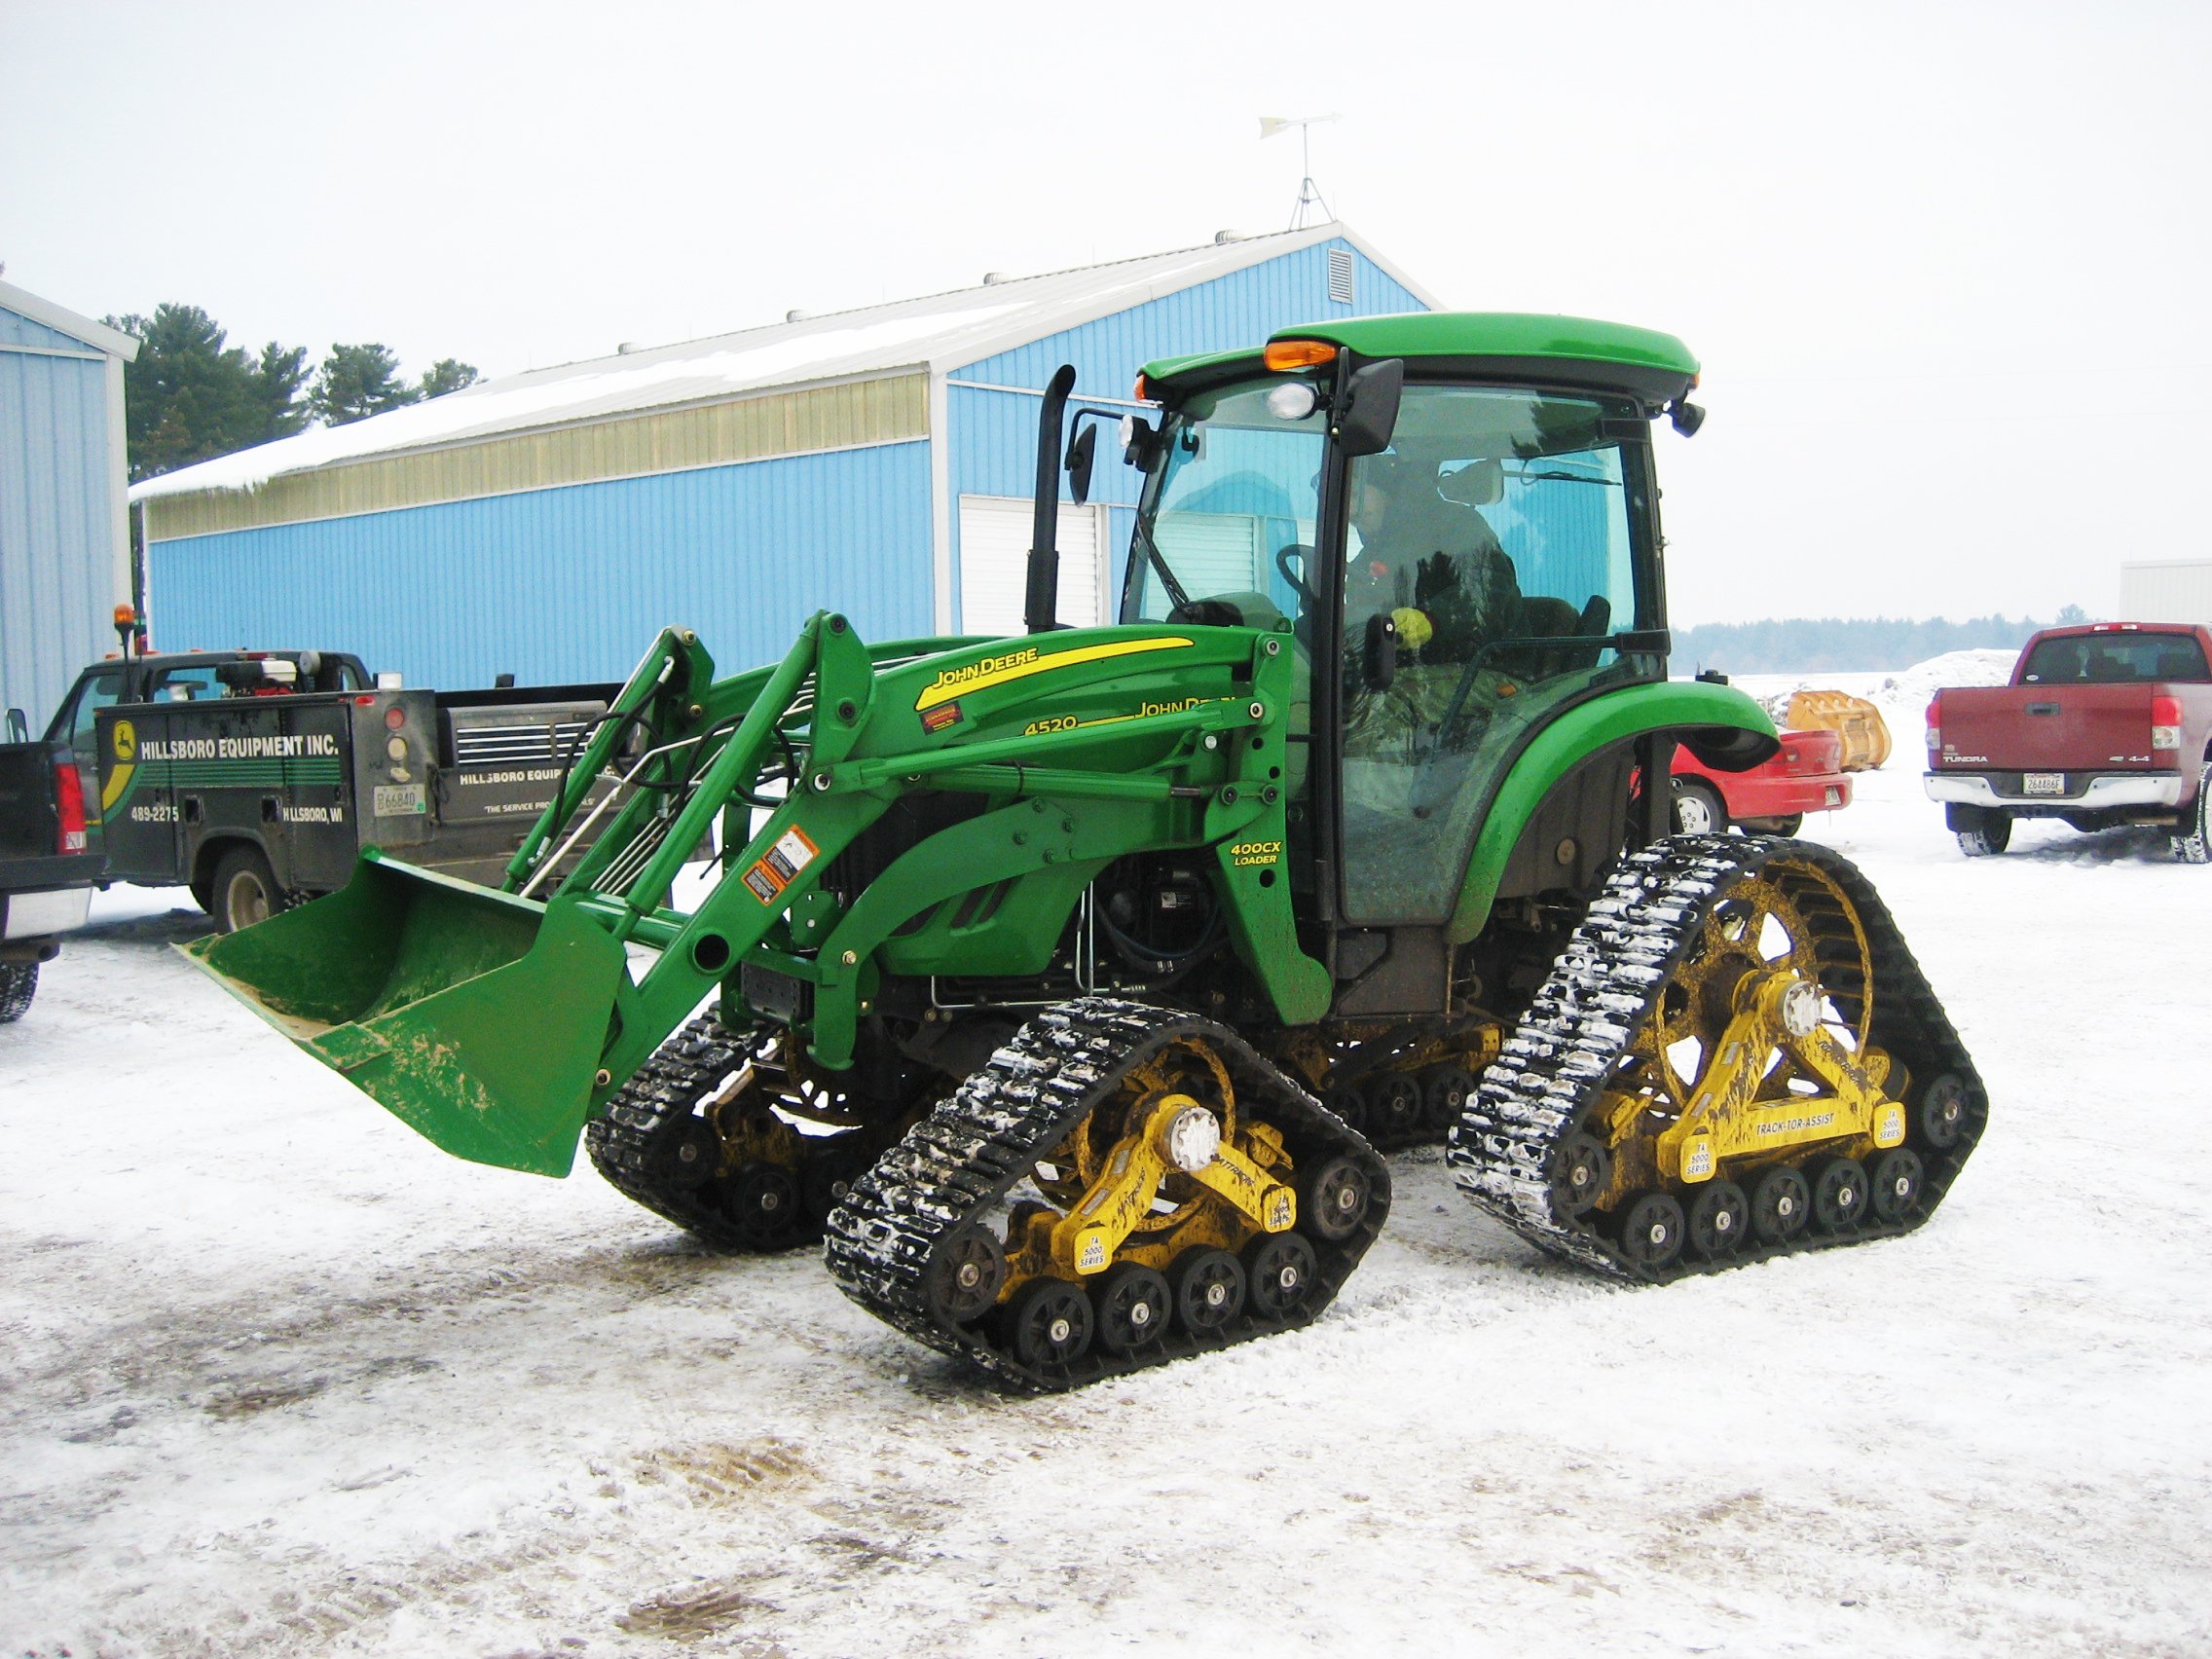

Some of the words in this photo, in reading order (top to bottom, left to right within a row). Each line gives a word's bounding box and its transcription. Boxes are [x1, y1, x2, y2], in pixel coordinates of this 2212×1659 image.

[932, 663, 978, 689] JOHN
[979, 646, 1039, 676] DEERE
[1137, 701, 1183, 719] JOHN
[1024, 716, 1078, 736] 4520
[140, 738, 216, 759] HILLSBORO
[218, 735, 304, 758] EQUIPMENT
[307, 733, 340, 756] INC.
[460, 770, 526, 786] HILLSBORO
[130, 806, 180, 823] 489-2275
[330, 806, 343, 823] WI
[502, 801, 534, 814] SERVICE
[1231, 841, 1282, 856] 400CX
[1234, 855, 1277, 866] LOADER
[1756, 1112, 1835, 1136] TRACK-TOR-ASSIST
[1686, 1162, 1711, 1174] SERIES
[1091, 1236, 1099, 1245] TA
[1084, 1245, 1103, 1257] 5000
[1080, 1255, 1104, 1267] SERIES
